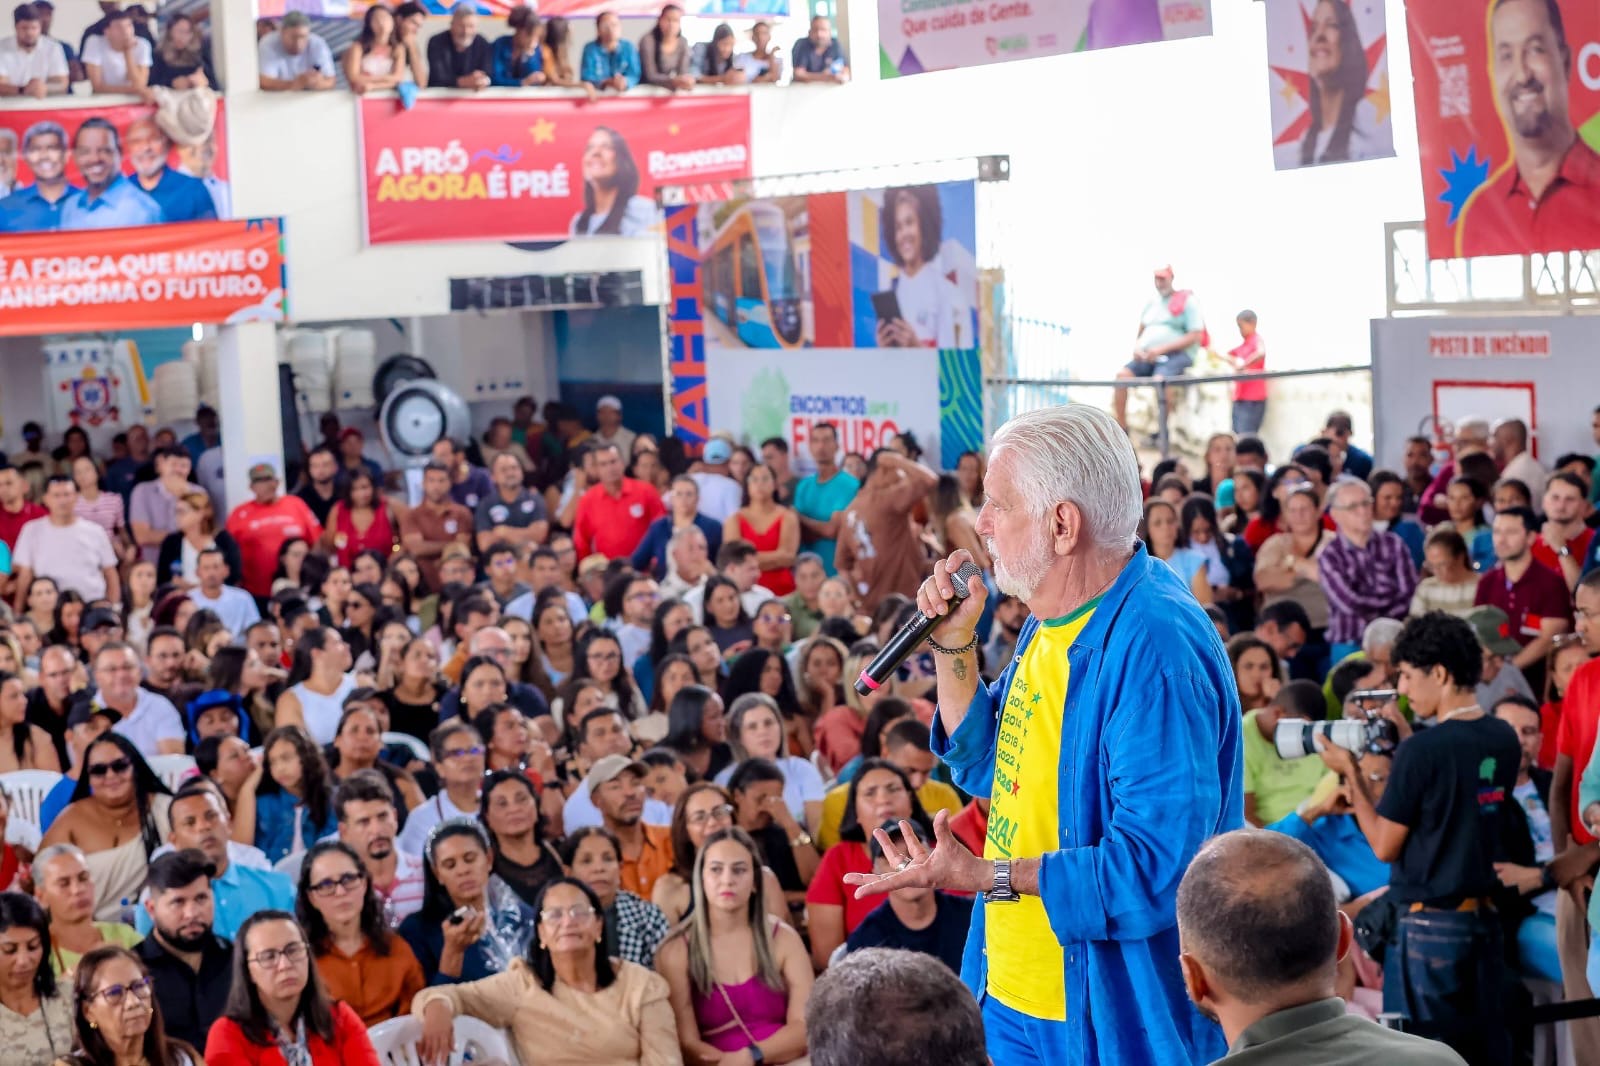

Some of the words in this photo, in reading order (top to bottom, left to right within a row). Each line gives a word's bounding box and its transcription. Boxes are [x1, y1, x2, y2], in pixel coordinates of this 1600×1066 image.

[902, 17, 928, 38] Que
[931, 9, 966, 31] cuida
[970, 7, 985, 25] de
[376, 148, 400, 176] A
[401, 139, 469, 175] PRÓ
[377, 172, 487, 201] AGORA
[487, 164, 508, 199] É
[511, 162, 571, 198] PRÉ
[10, 258, 30, 281] A
[33, 256, 119, 285] FORÇA
[119, 252, 169, 281] QUE
[175, 249, 247, 275] MOVE
[247, 247, 270, 271] O
[140, 279, 162, 302] O
[165, 273, 267, 300] FUTURO.
[667, 203, 711, 457] AHIA
[1430, 335, 1468, 354] POSTO
[1473, 335, 1486, 354] DE
[1490, 331, 1548, 354] INCÊNDIO
[790, 395, 866, 414] ENCONTROS
[792, 417, 899, 457] FURO
[1003, 712, 1021, 728] 2014
[1000, 730, 1018, 748] 2018
[996, 767, 1012, 793] 026
